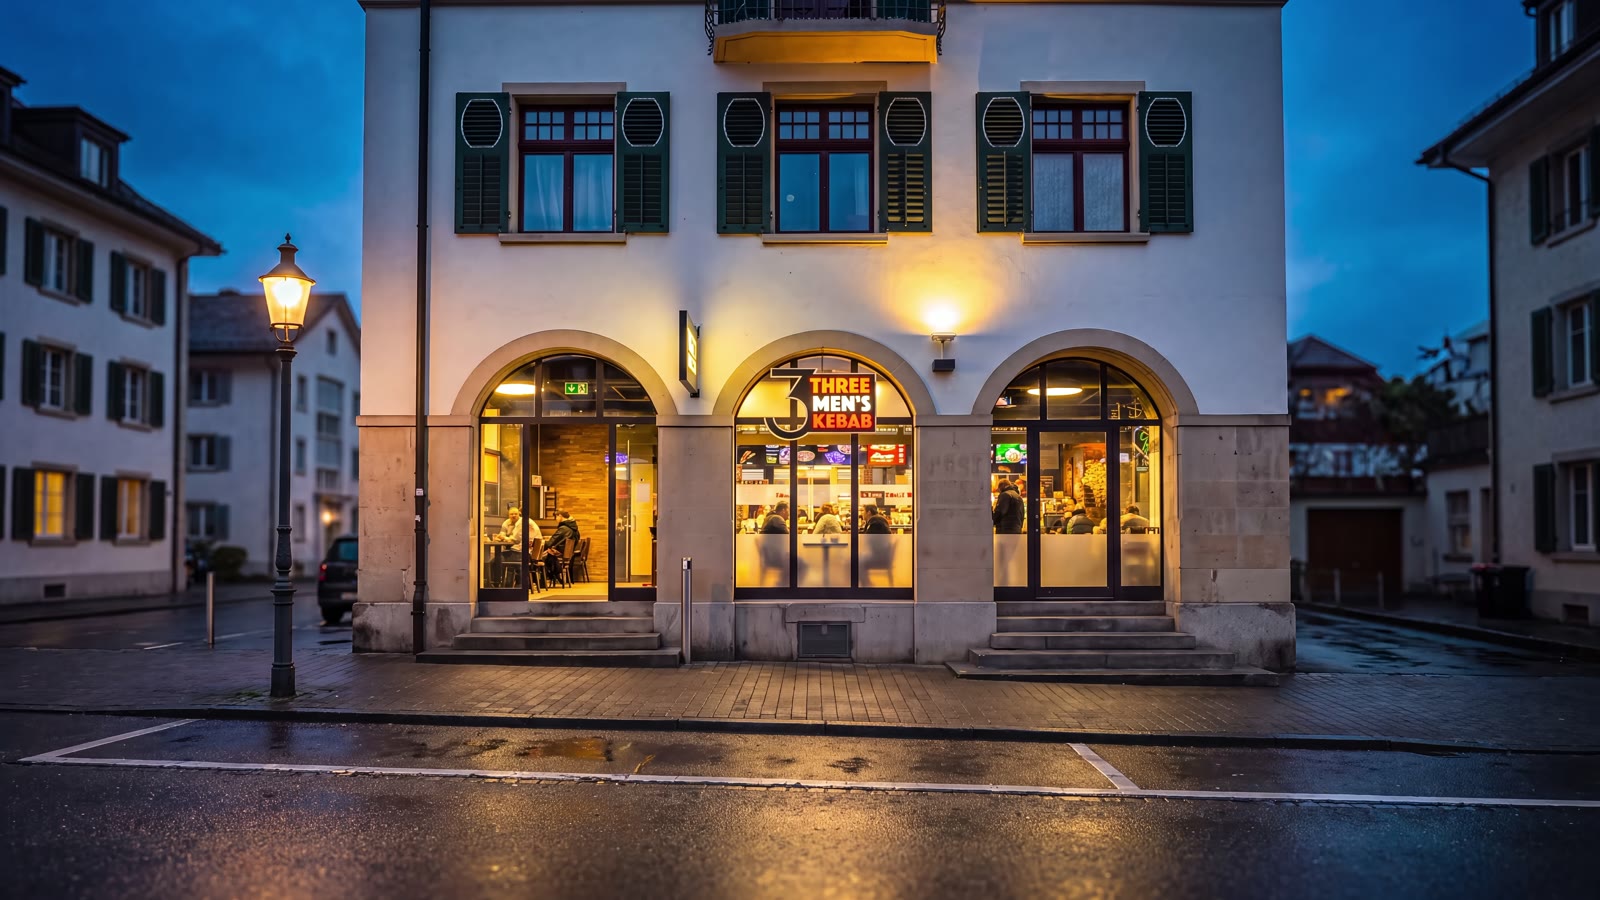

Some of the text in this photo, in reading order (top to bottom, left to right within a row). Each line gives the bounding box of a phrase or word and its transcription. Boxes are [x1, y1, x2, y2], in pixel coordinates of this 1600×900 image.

[809, 377, 871, 393] THREE
[764, 368, 817, 440] 3
[812, 395, 872, 412] MEN'S
[812, 413, 873, 429] KEBAB
